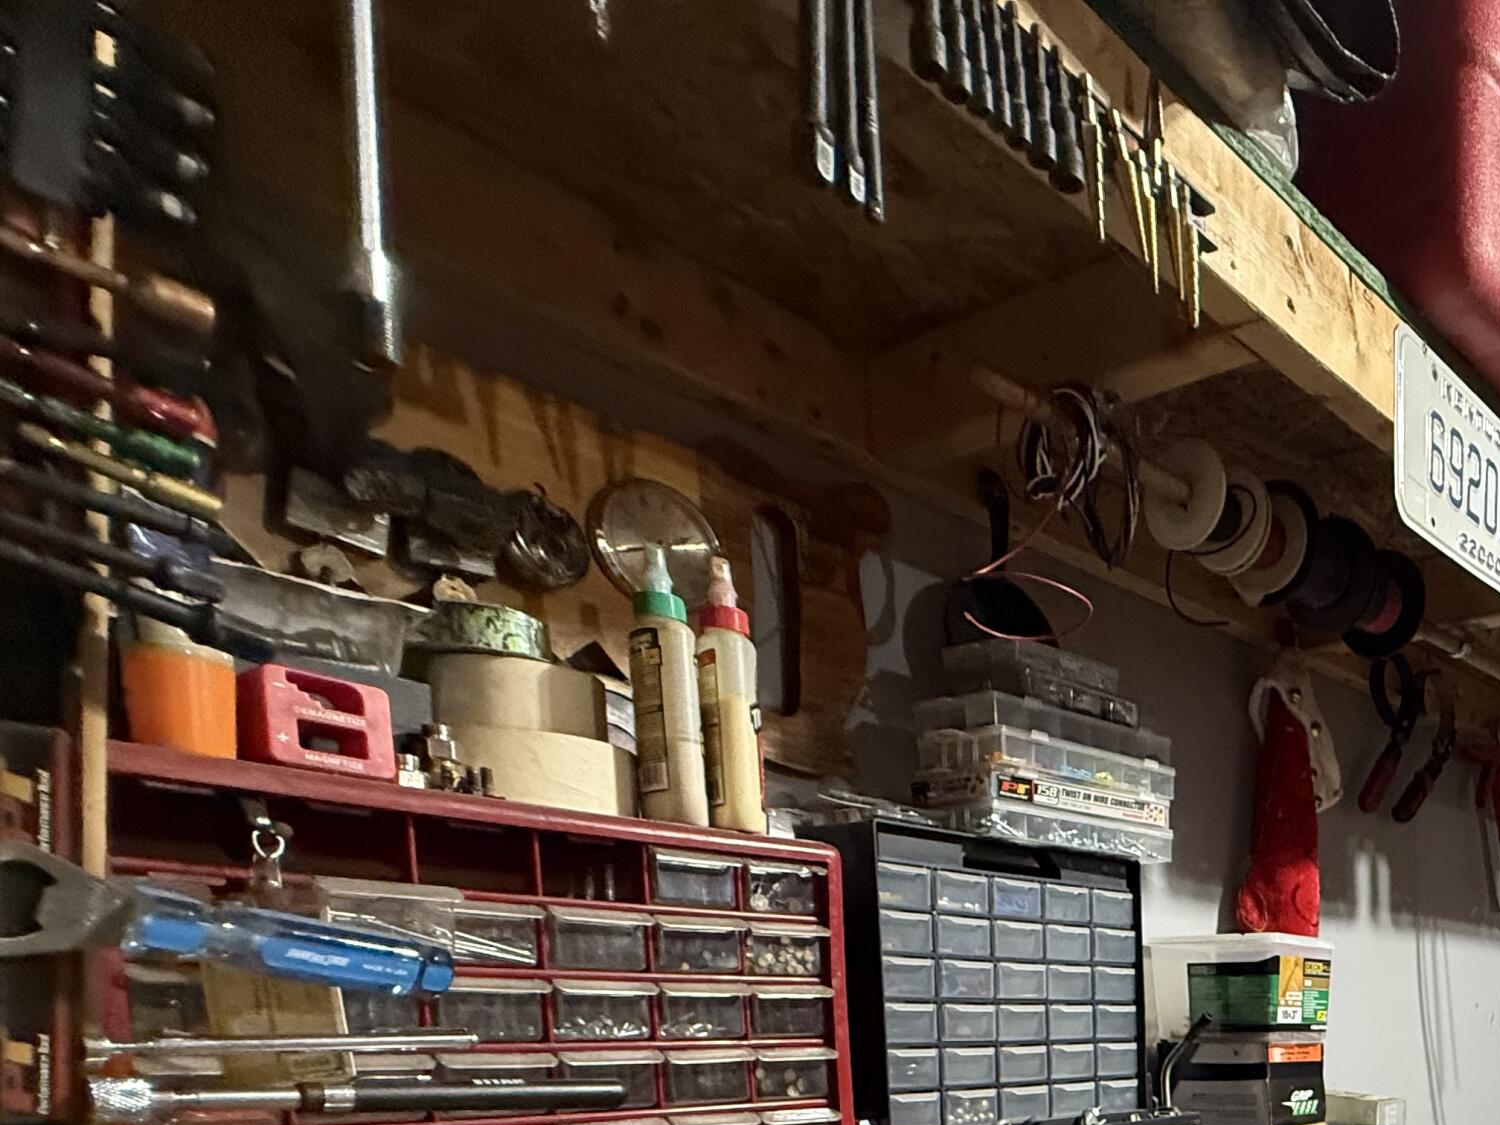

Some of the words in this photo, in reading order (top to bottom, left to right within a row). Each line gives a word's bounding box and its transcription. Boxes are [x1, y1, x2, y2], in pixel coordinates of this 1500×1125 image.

[294, 705, 366, 727] DEMAGNETIZE
[304, 752, 364, 772] MAGNETIZE
[1062, 788, 1081, 800] TWIST
[1082, 792, 1092, 801] ON
[1093, 793, 1109, 804] WIRE
